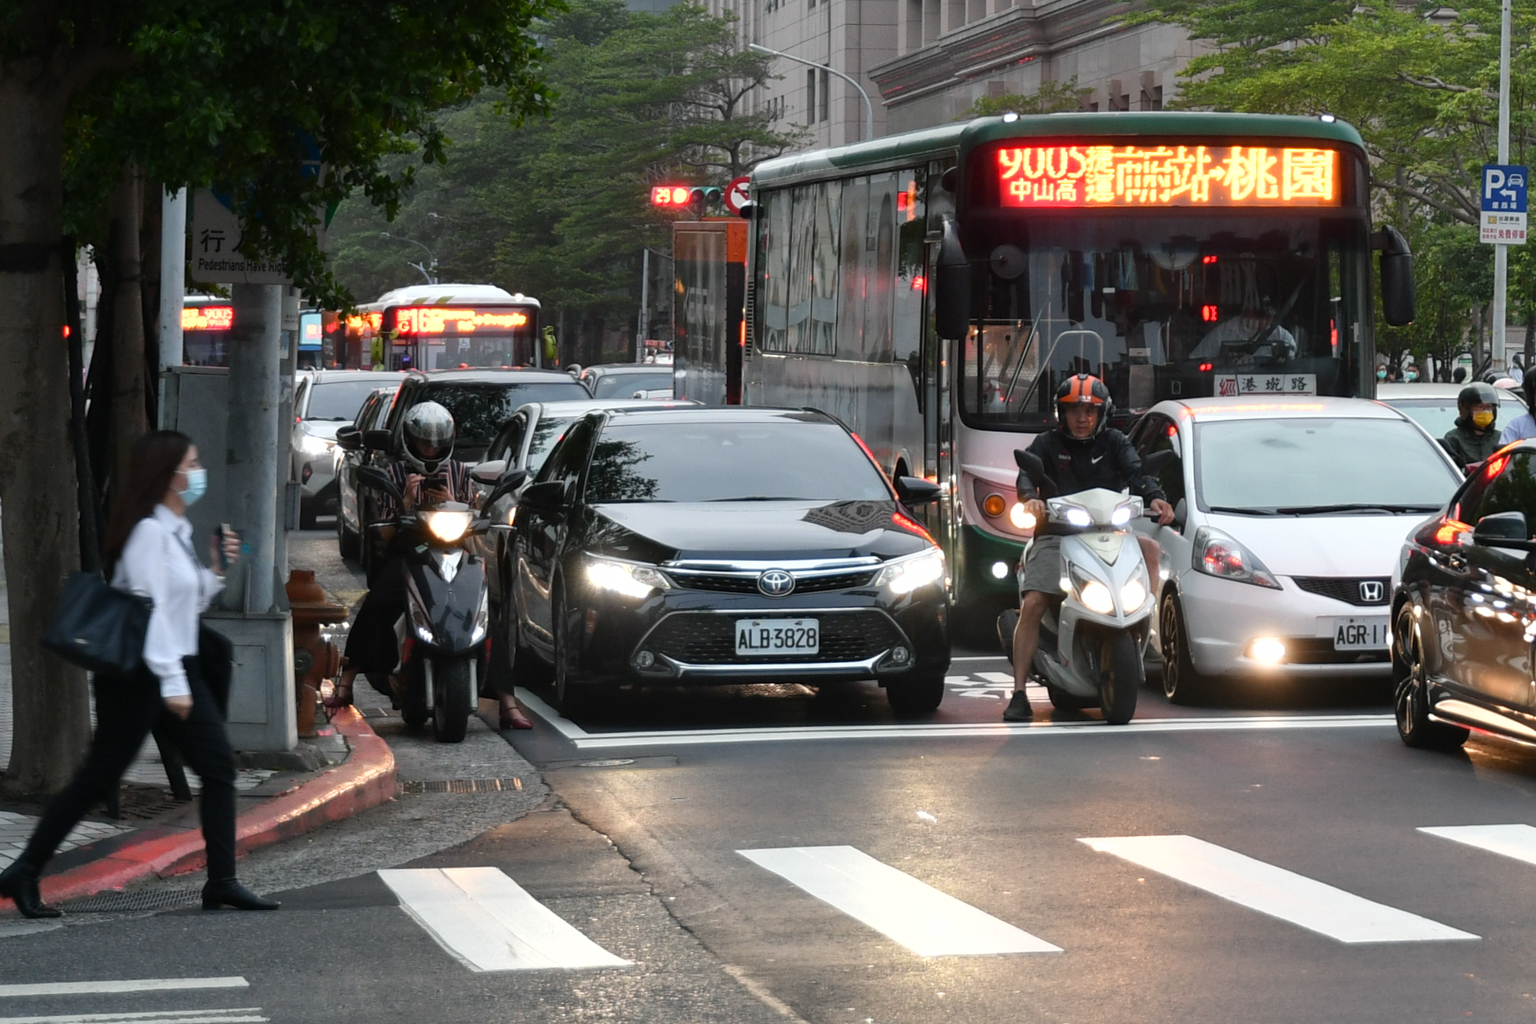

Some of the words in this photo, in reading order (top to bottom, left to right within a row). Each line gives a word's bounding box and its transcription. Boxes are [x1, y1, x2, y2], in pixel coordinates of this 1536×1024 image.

[1010, 178, 1077, 202] 中山高
[1485, 169, 1506, 199] P
[198, 257, 245, 271] Pedestrians
[246, 258, 267, 272] Have
[268, 259, 288, 276] Rig
